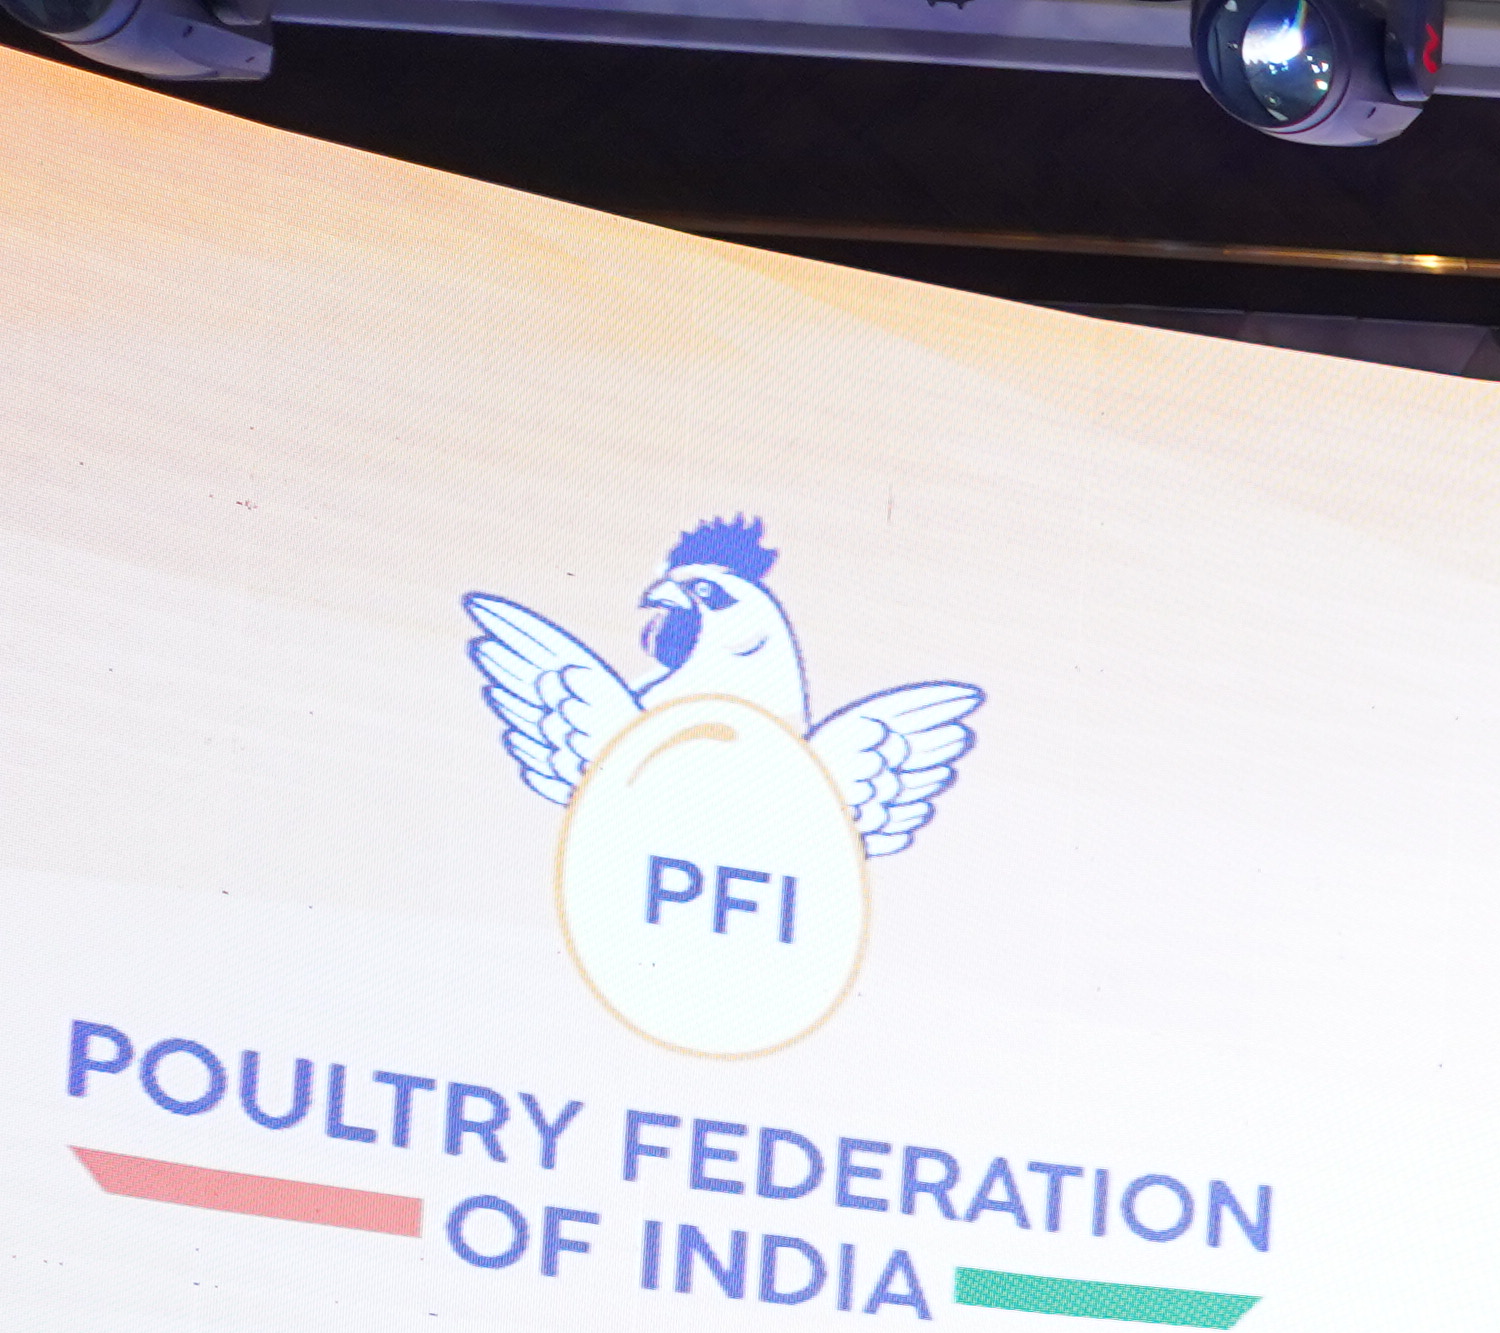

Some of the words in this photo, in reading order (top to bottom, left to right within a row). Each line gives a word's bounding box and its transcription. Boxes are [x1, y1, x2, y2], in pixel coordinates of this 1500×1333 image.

[643, 853, 798, 945] PFI
[65, 1018, 583, 1171] POULTRY
[621, 1108, 1273, 1255] FEDERATION
[444, 1192, 600, 1278] OF
[640, 1219, 933, 1321] INDIA
